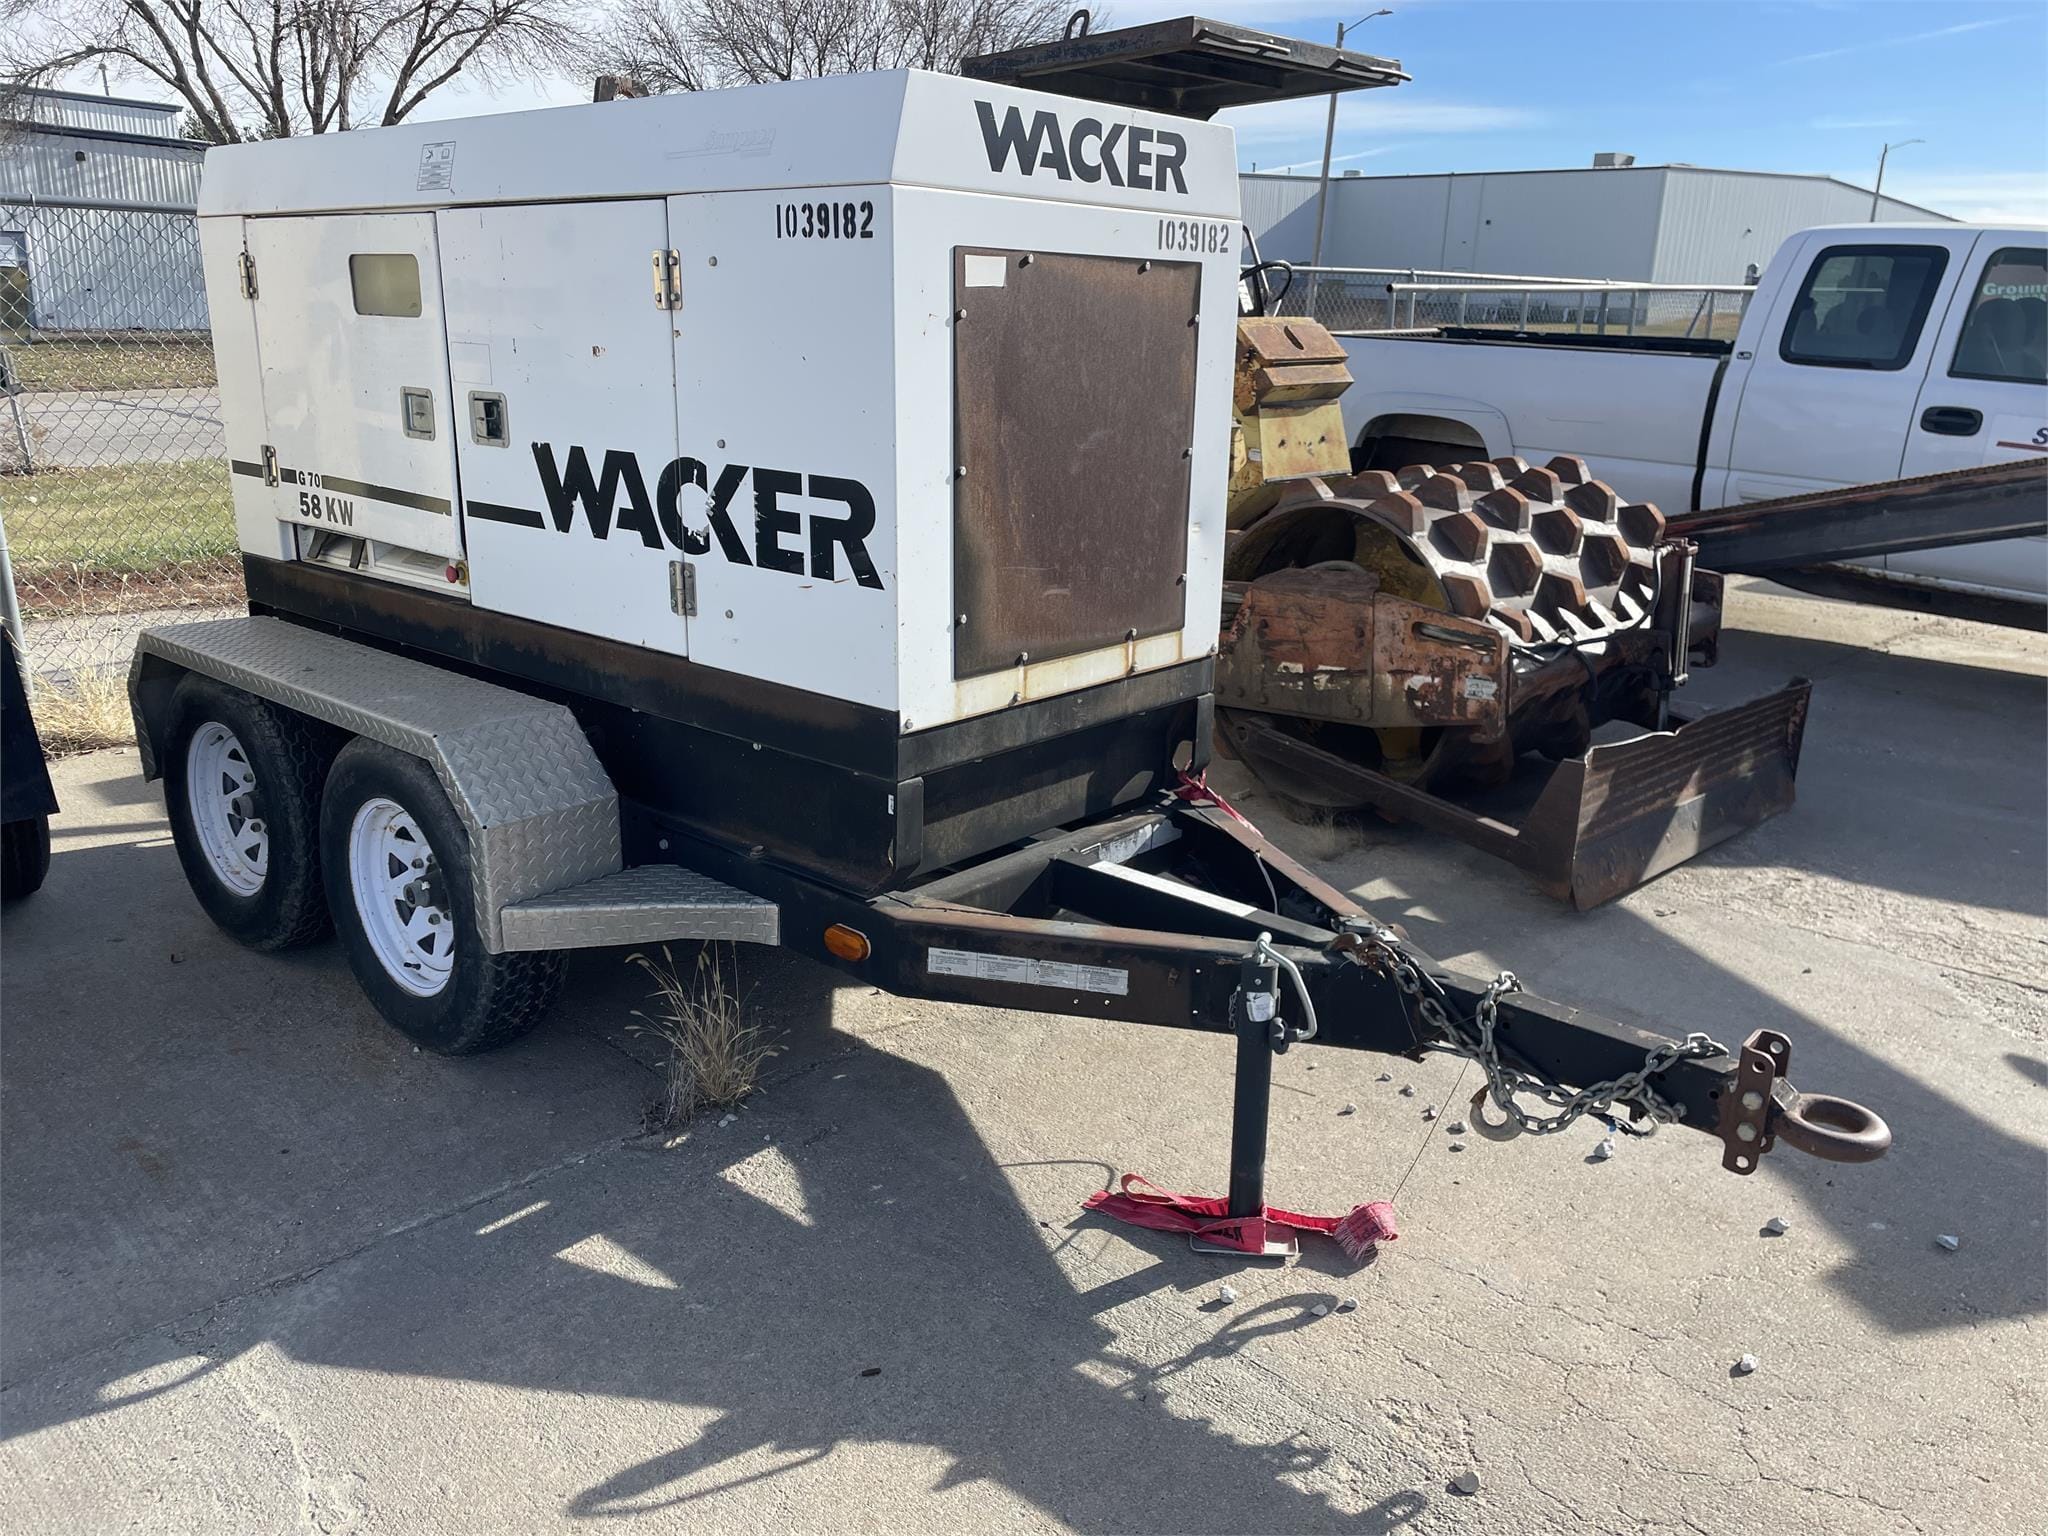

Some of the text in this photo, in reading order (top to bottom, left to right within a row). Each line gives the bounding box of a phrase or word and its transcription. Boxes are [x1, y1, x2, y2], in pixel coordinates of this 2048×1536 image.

[973, 100, 1189, 195] WACKER
[775, 200, 875, 240] 1039182
[1157, 219, 1230, 254] 1039182
[298, 470, 321, 488] G 70
[299, 491, 354, 527] 58 KW
[531, 441, 885, 590] WACKER
